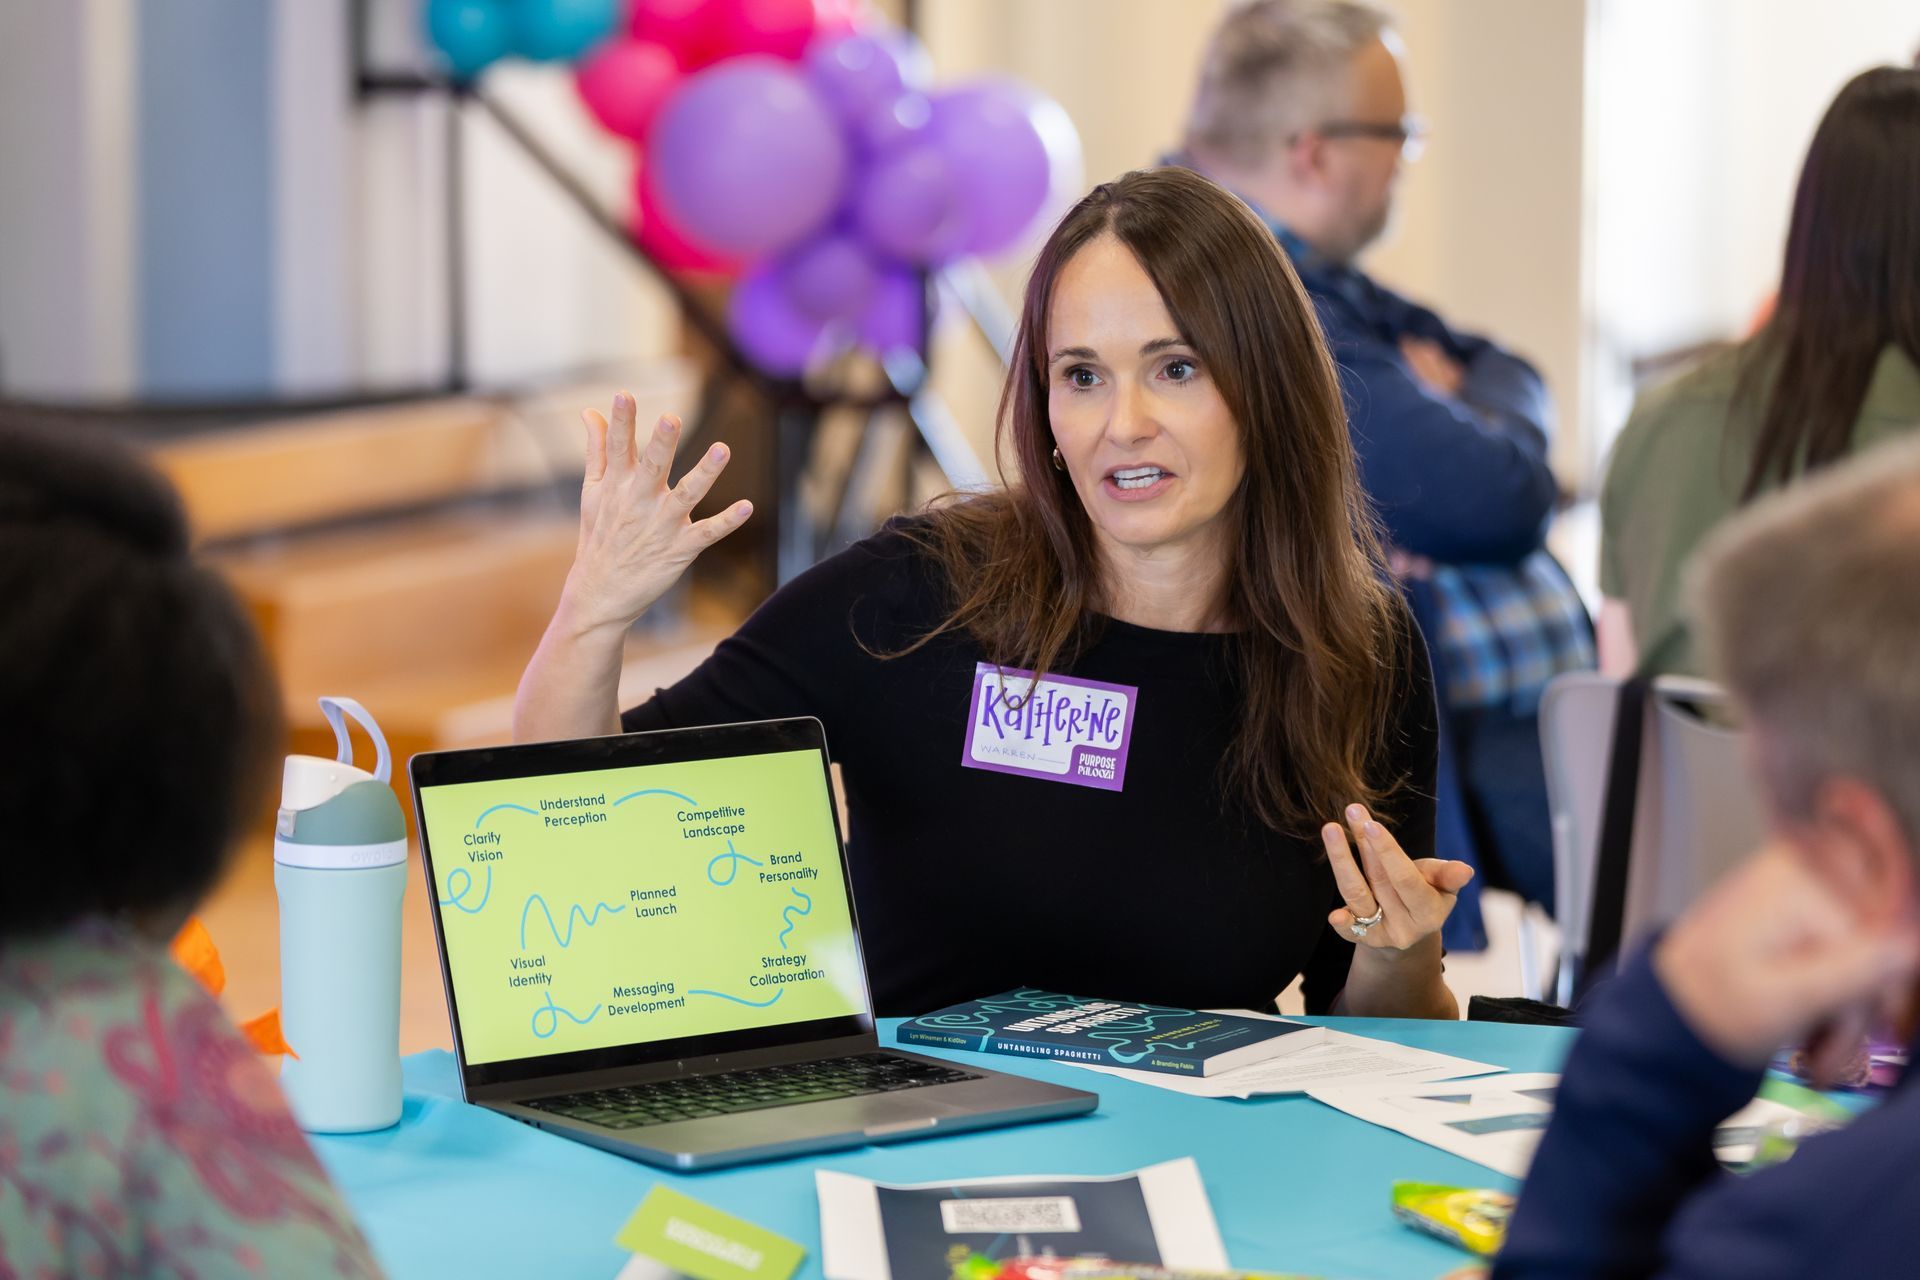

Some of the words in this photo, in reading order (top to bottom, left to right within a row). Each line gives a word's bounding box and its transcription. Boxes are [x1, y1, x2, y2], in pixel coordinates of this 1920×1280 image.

[981, 743, 1036, 761] WARREN
[1079, 752, 1117, 770] PURPOSE
[540, 794, 606, 811] Understand
[544, 812, 607, 827] Perception
[677, 806, 745, 822] Competitive
[463, 832, 501, 846] Clarify
[683, 823, 745, 839] Landscape
[468, 850, 503, 863] Vision
[770, 852, 802, 865] Brand
[759, 867, 818, 883] Personality
[630, 885, 676, 901] Planned
[635, 903, 677, 918] Launch
[510, 955, 546, 970] Visual
[761, 954, 807, 968] Strategy
[509, 973, 552, 987] Identity
[749, 968, 825, 987] Collaboration
[613, 981, 675, 998] Messaging
[608, 996, 685, 1016] Development
[997, 1043, 1051, 1055] UNTANGLING
[1054, 1049, 1101, 1060] SPAGHETTI
[1156, 1060, 1179, 1068] Branding
